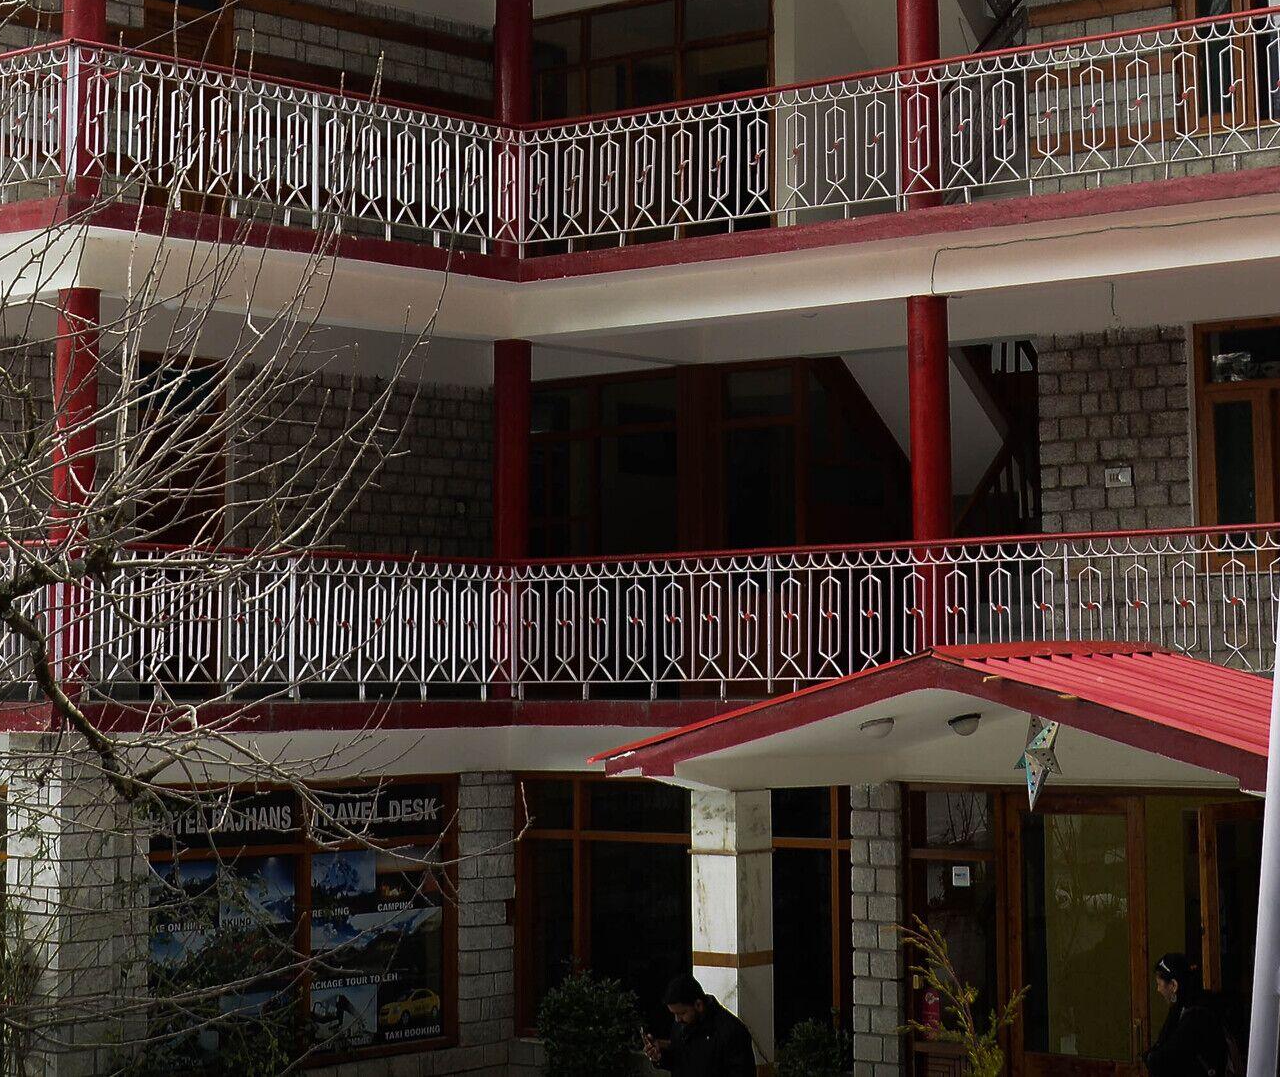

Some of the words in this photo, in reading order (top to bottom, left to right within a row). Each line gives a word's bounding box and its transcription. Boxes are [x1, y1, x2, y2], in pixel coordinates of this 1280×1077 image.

[211, 805, 292, 833] RAJHANS
[388, 797, 437, 822] DESK
[310, 979, 345, 990] ACKAGE
[346, 977, 368, 986] TOUR
[370, 975, 380, 984] TO
